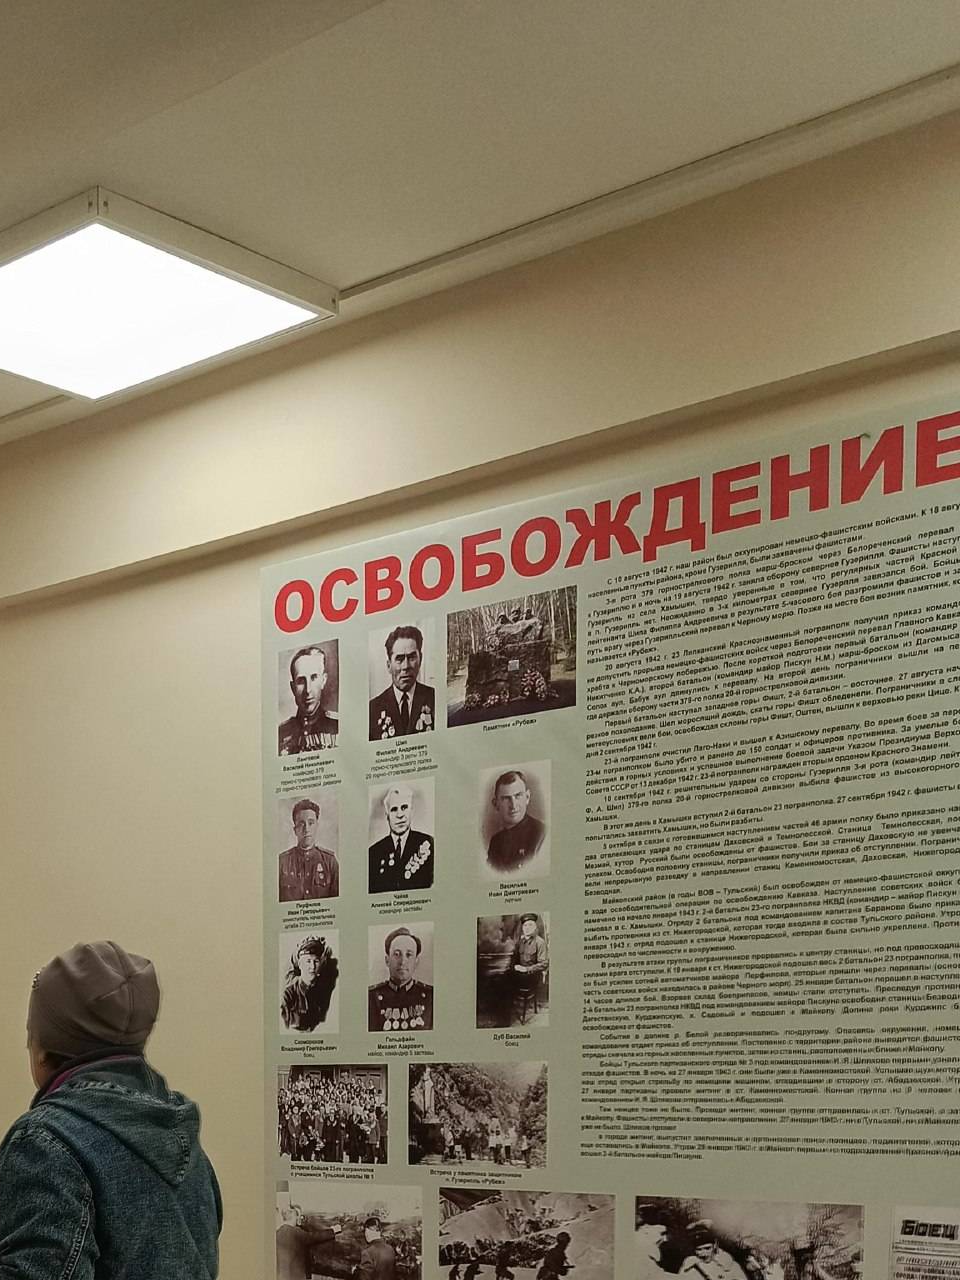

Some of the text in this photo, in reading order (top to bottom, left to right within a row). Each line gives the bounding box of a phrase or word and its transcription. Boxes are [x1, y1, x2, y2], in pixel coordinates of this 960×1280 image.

[274, 411, 960, 634] ОСВОБОЖДЕНИЕ
[623, 570, 650, 581] августа
[652, 565, 667, 575] 1942
[675, 562, 690, 570] наш
[692, 556, 714, 568] район
[716, 553, 732, 561] был
[734, 541, 783, 557] оккупирован
[785, 521, 873, 546] немецко-фашистским
[875, 512, 918, 526] войсками.
[587, 534, 862, 598] населенные пункты района, кроме Гузерипля, были захвачены фашистами.
[587, 615, 622, 628] Гузерипль
[639, 608, 656, 616] села
[660, 600, 696, 612] Хамышки,
[701, 594, 728, 604] твердо
[732, 584, 775, 599] уверенные
[790, 578, 806, 586] том,
[830, 563, 880, 579] регулярных
[885, 554, 915, 566] частей
[920, 546, 957, 560] Красной
[620, 593, 636, 603] рота
[641, 589, 653, 597] 379
[657, 575, 724, 594] горнострелкового
[728, 569, 750, 579] полка
[755, 556, 813, 573] марш-броском
[818, 550, 841, 560] через
[847, 534, 911, 554] Белореченский
[917, 526, 954, 539] перевал
[586, 651, 626, 664] называется
